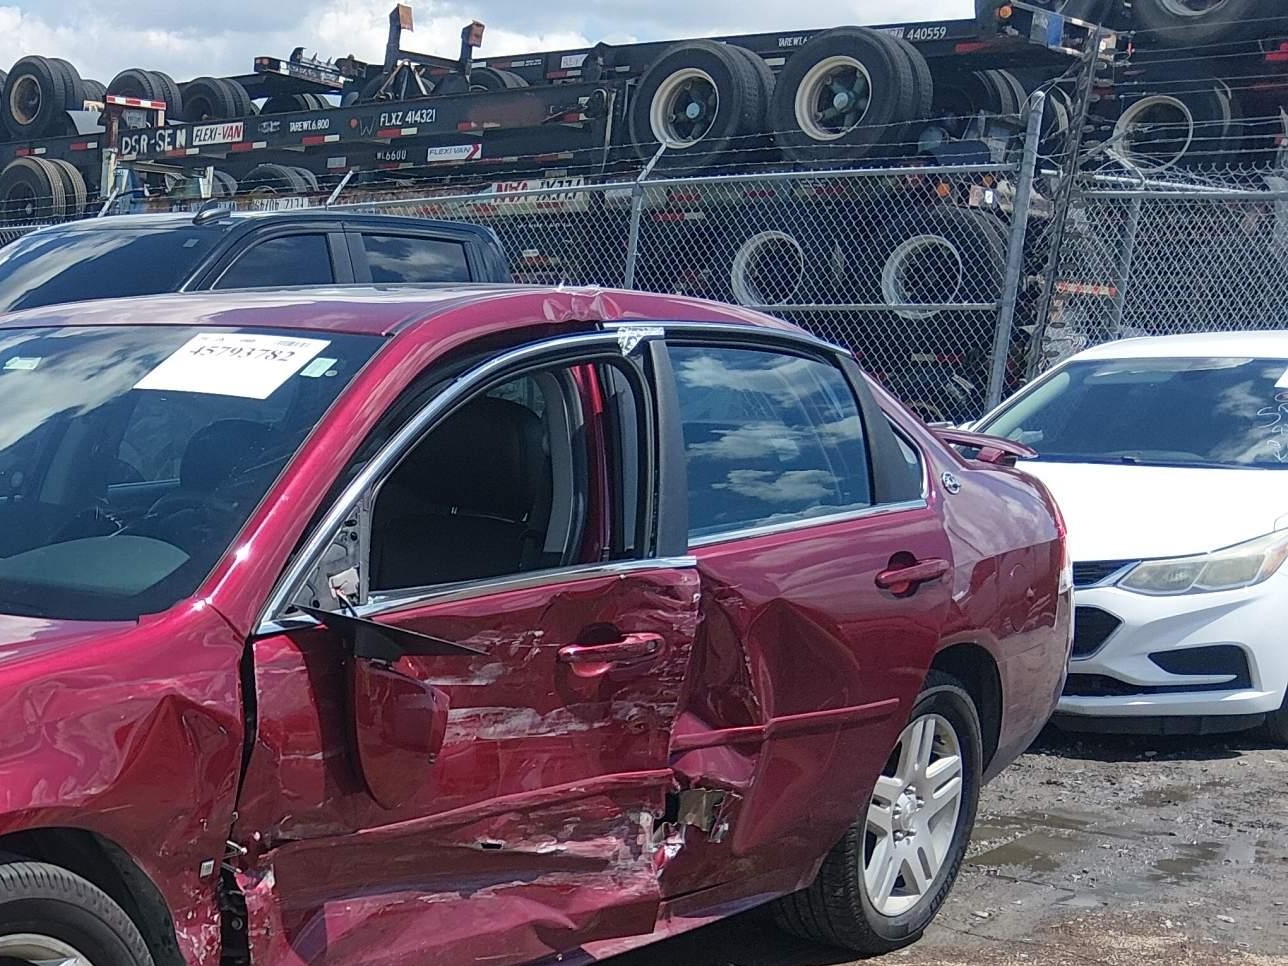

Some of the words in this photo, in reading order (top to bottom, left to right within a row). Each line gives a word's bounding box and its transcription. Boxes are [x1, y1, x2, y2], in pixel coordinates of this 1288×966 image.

[906, 26, 947, 40] 440559
[380, 111, 403, 126] FLXZ
[405, 108, 436, 124] 414321
[193, 123, 242, 142] FLEXI-VAN
[190, 345, 295, 362] 45793782
